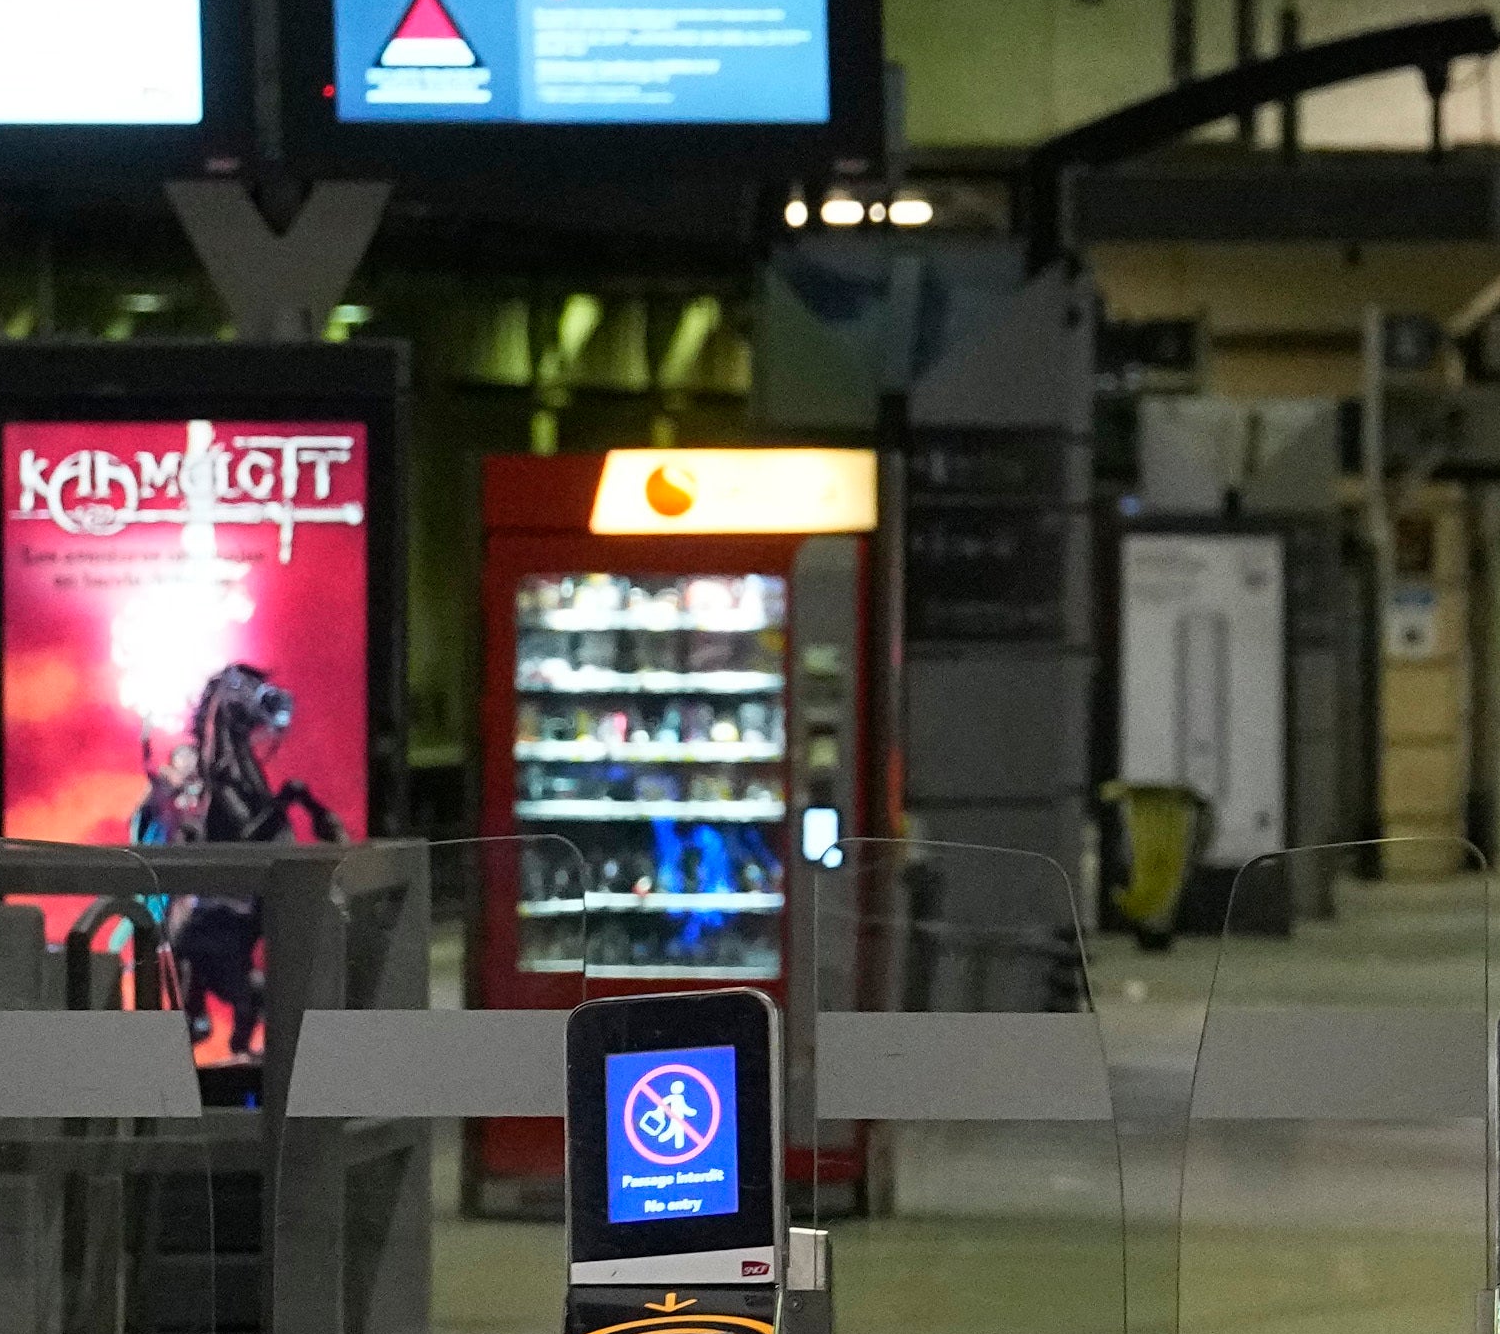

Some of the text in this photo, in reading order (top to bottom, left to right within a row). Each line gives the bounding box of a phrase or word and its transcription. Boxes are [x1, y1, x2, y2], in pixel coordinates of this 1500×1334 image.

[621, 1168, 725, 1189] Passage interdit
[644, 1198, 703, 1213] No entry
